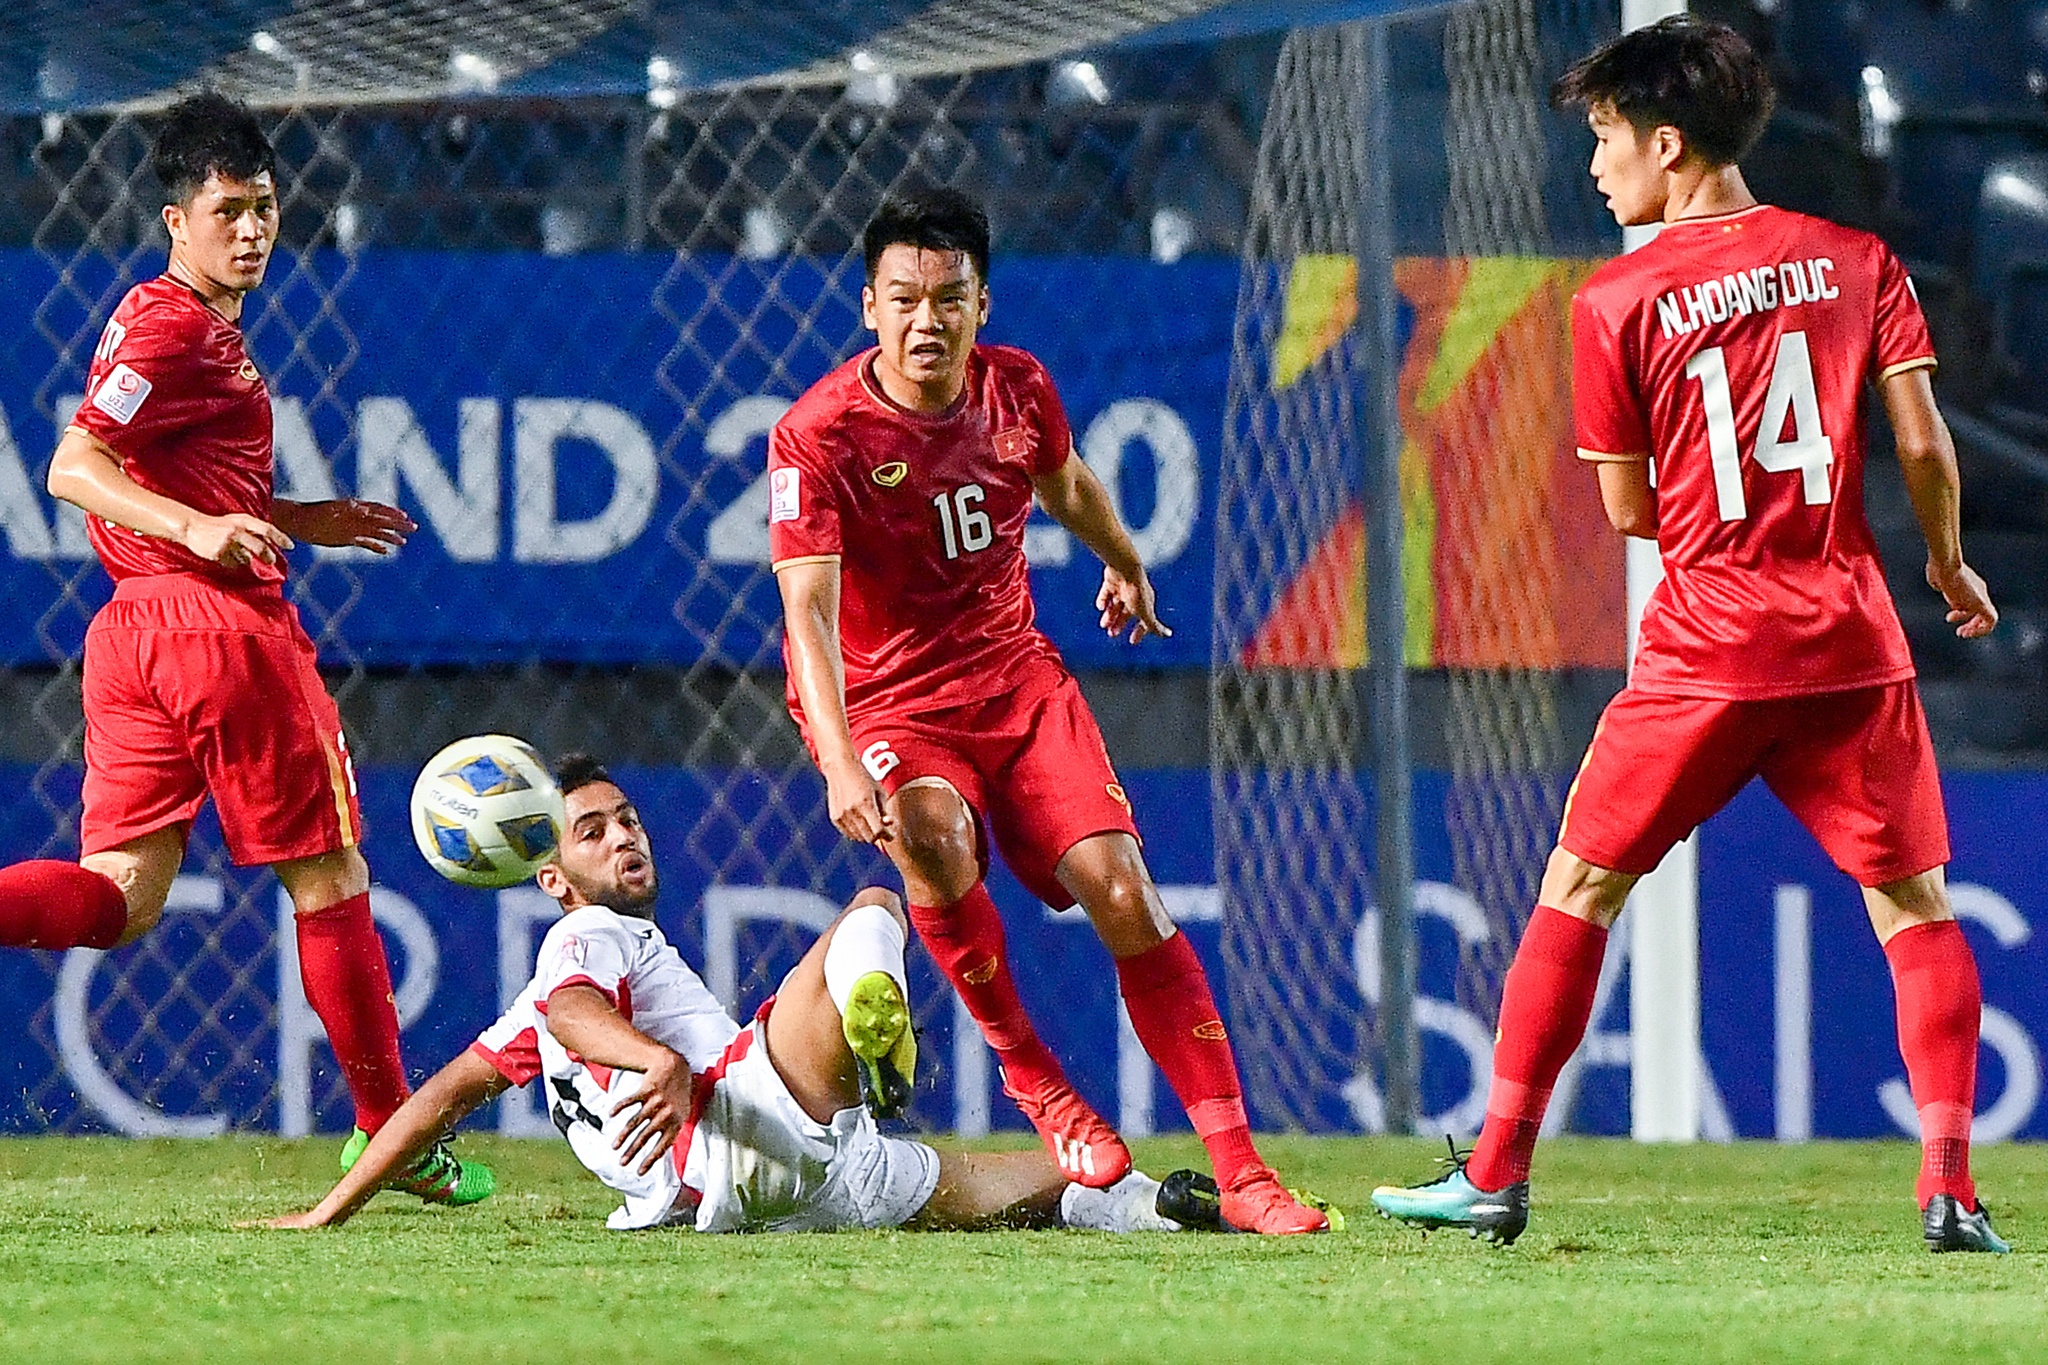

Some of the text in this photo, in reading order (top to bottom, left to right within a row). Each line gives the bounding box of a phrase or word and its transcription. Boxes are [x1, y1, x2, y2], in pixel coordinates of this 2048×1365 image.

[1778, 257, 1840, 308] DUC
[1686, 330, 1834, 523] 14
[933, 484, 993, 560] 16
